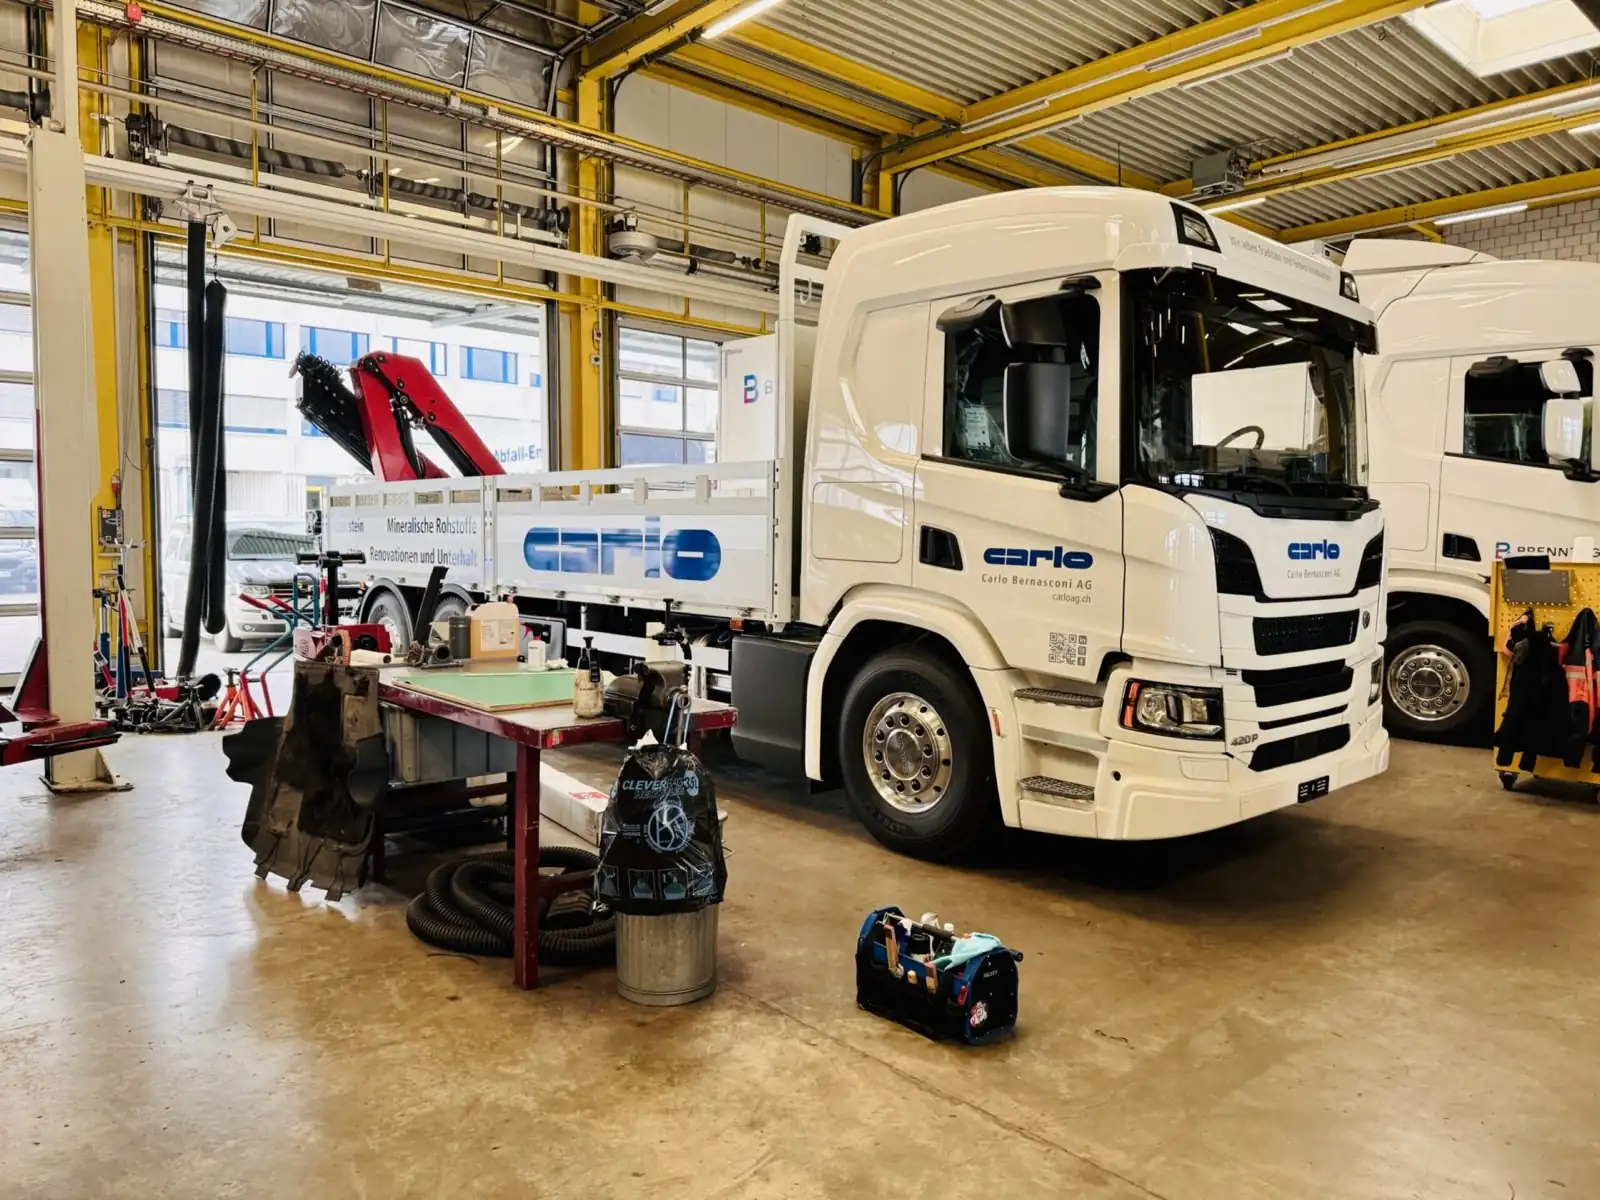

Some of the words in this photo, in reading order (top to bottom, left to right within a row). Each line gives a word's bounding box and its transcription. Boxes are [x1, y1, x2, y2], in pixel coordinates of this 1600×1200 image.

[387, 517, 434, 534] Mineralische
[436, 517, 478, 535] Rohstoffe
[370, 546, 419, 564] Renovationen
[420, 548, 435, 565] und
[437, 549, 478, 567] Unterhalt
[523, 516, 722, 581] carlo
[983, 546, 1093, 569] carlo
[1287, 539, 1340, 560] carlo
[982, 573, 1008, 584] Carlo
[1012, 575, 1072, 589] Bernasconi
[1076, 580, 1093, 590] AG
[1287, 568, 1303, 579] Carlo
[1304, 568, 1333, 579] Bernasconi
[1333, 568, 1341, 578] AG
[1052, 592, 1091, 604] carloag.ch
